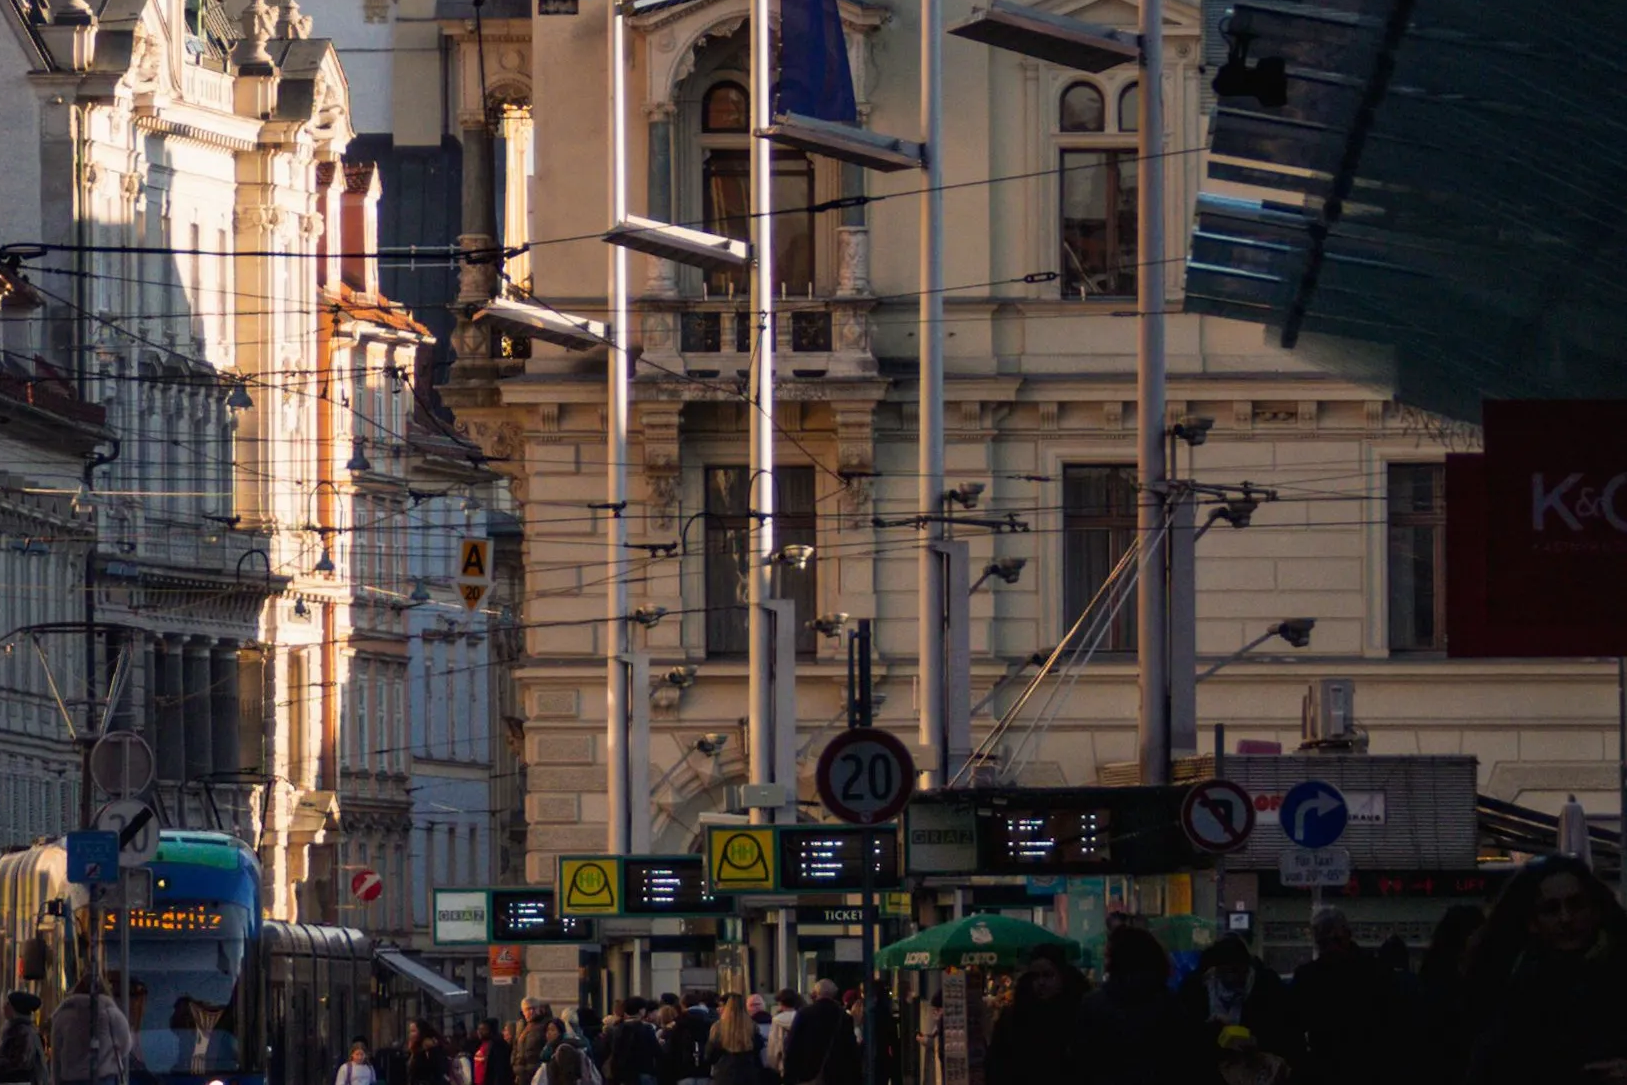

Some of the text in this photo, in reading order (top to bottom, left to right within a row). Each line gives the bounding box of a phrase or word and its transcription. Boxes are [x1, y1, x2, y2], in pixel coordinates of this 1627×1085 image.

[461, 544, 486, 575] A
[465, 586, 481, 601] 20
[841, 753, 892, 800] 20
[911, 829, 974, 845] GRAZ
